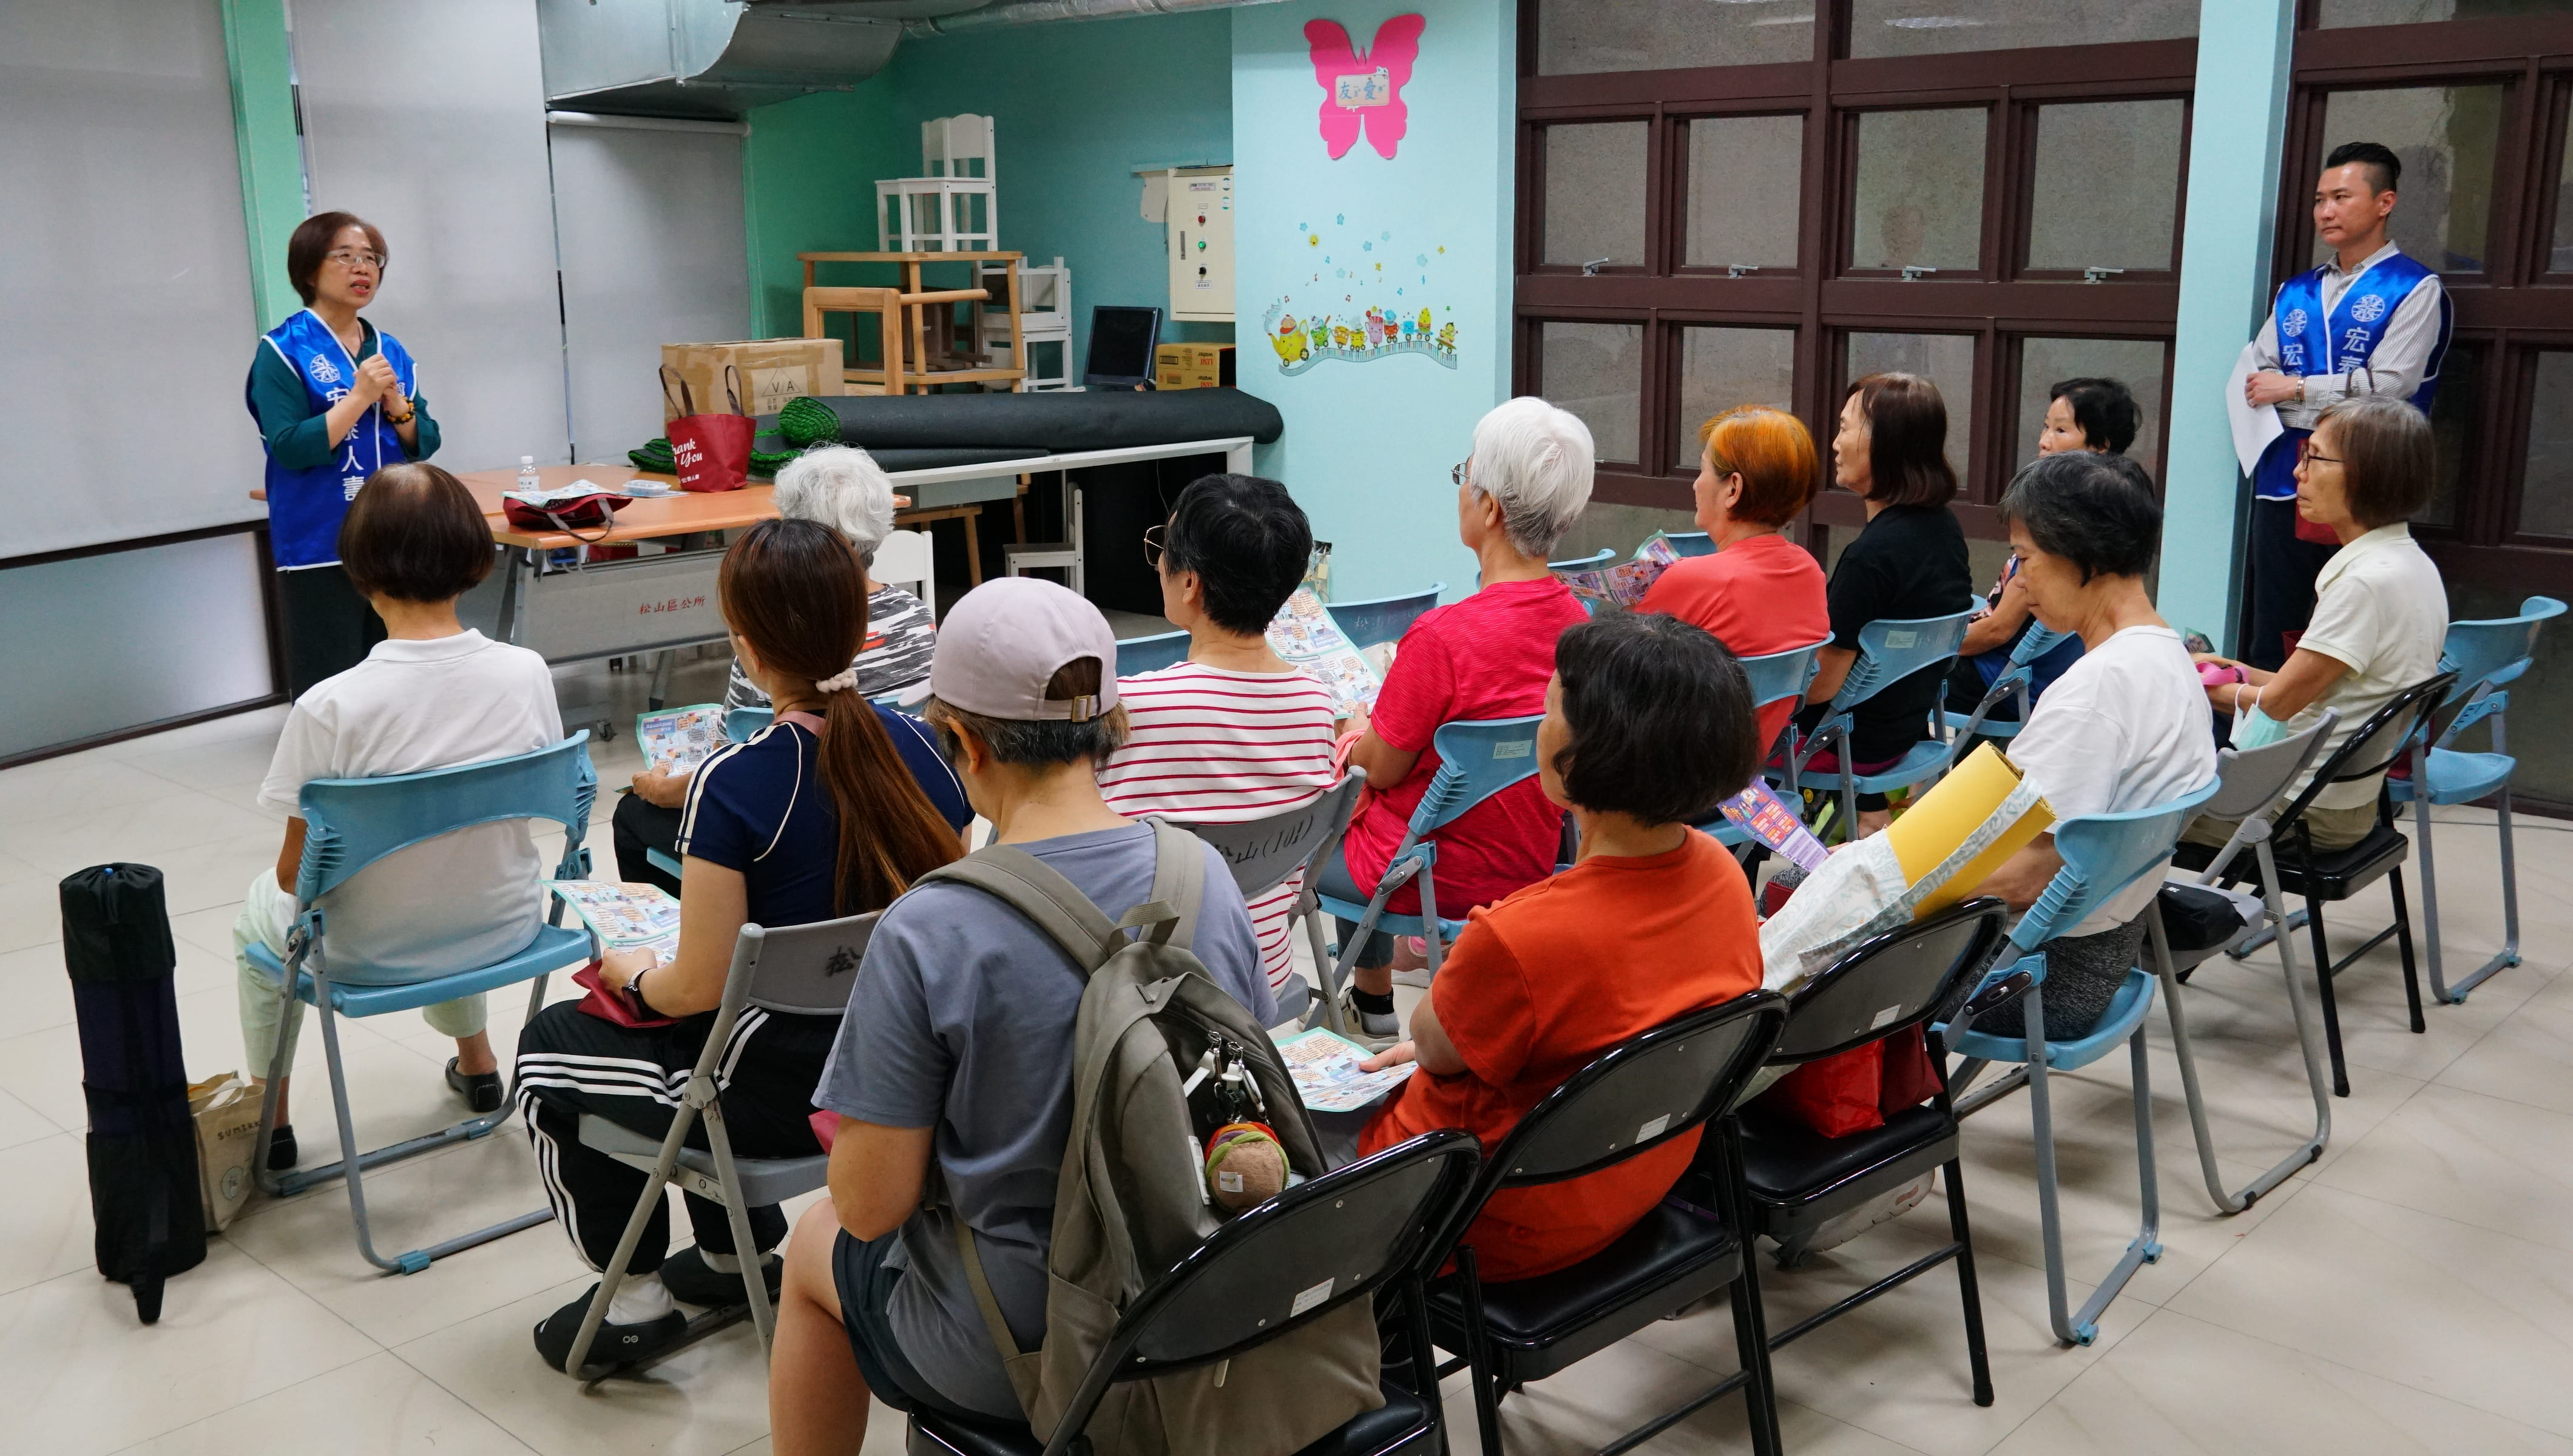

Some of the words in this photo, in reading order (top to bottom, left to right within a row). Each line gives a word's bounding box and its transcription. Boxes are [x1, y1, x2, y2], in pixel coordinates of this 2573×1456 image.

[2282, 342, 2304, 377] 宏
[671, 438, 697, 455] hank
[680, 451, 703, 468] You
[639, 595, 706, 615] 松山區公所
